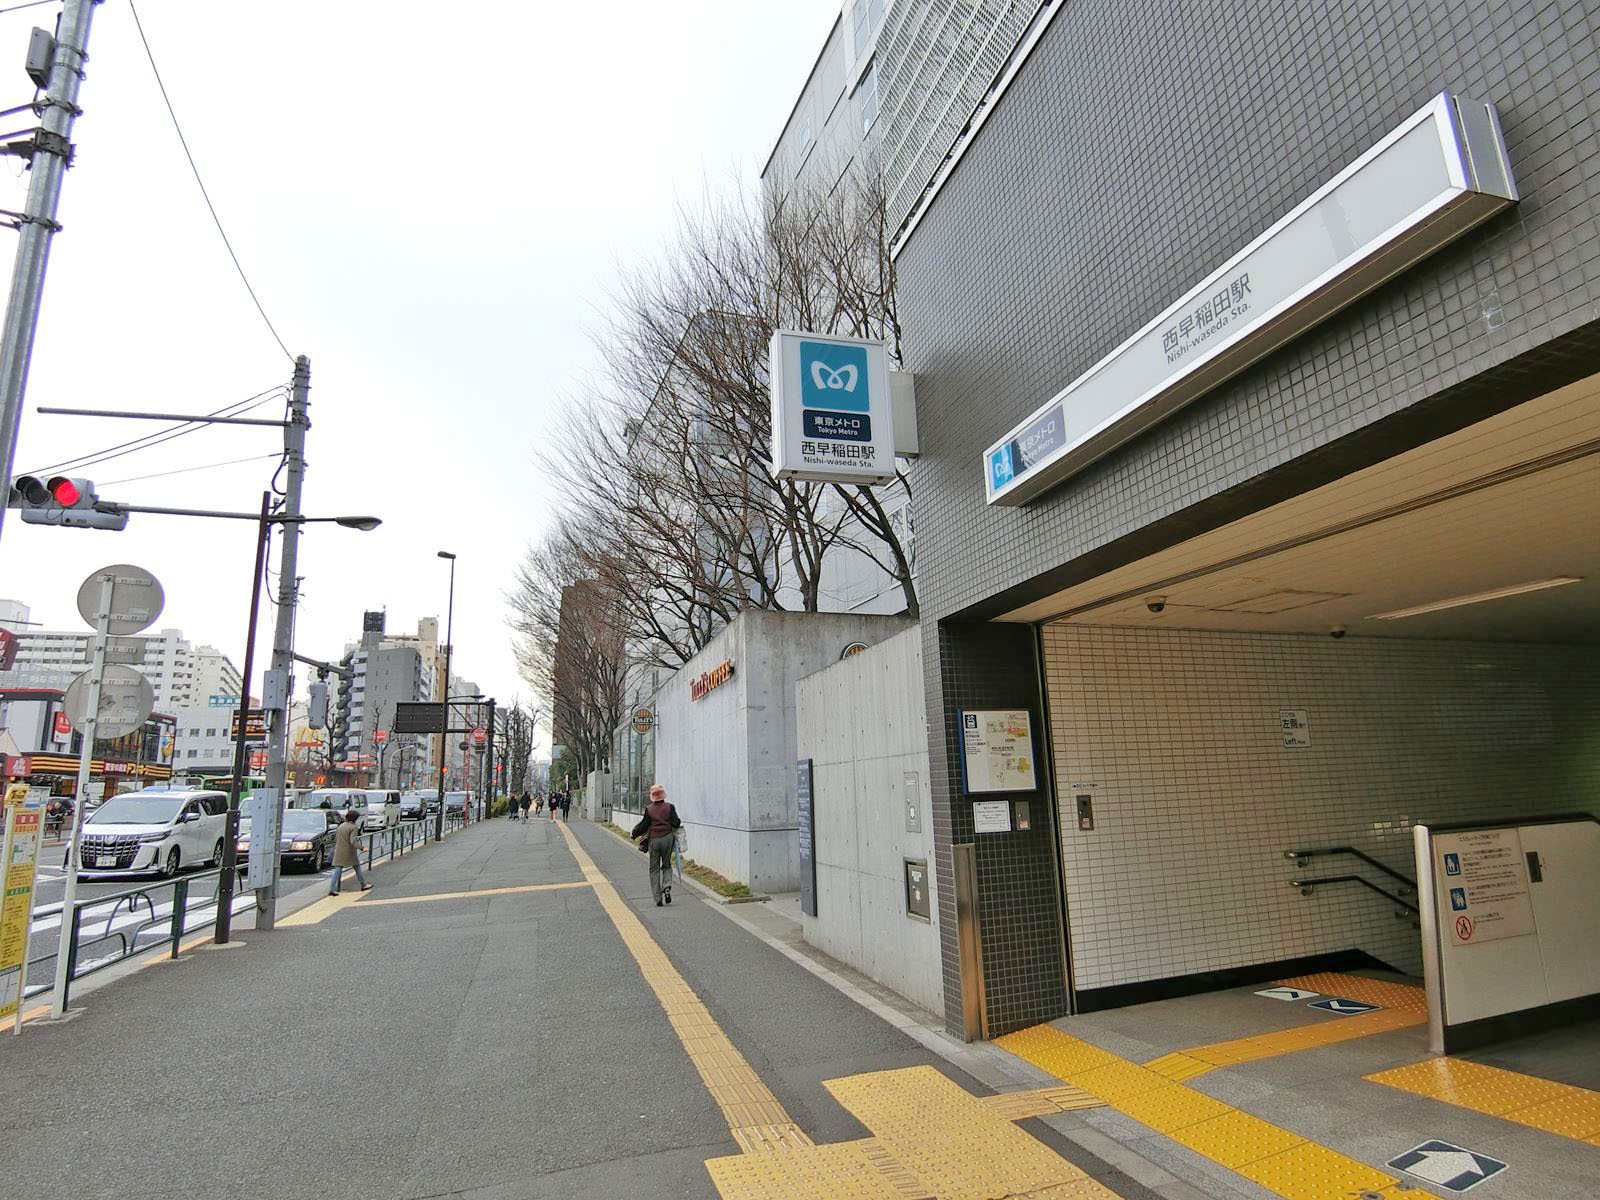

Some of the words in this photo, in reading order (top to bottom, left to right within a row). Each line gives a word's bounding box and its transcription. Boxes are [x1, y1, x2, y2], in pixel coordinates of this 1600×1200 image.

[1162, 272, 1252, 354] 西早稲田駅
[1167, 317, 1229, 365] Nishi-waseda
[1231, 303, 1252, 324] Sta.
[814, 415, 860, 428] 東京メトロ
[817, 426, 837, 435] Tokyo
[838, 428, 858, 436] Metro
[801, 440, 875, 460] 西早稲田駅
[803, 456, 857, 467] Nishi-waseda
[859, 458, 874, 468] Sta.
